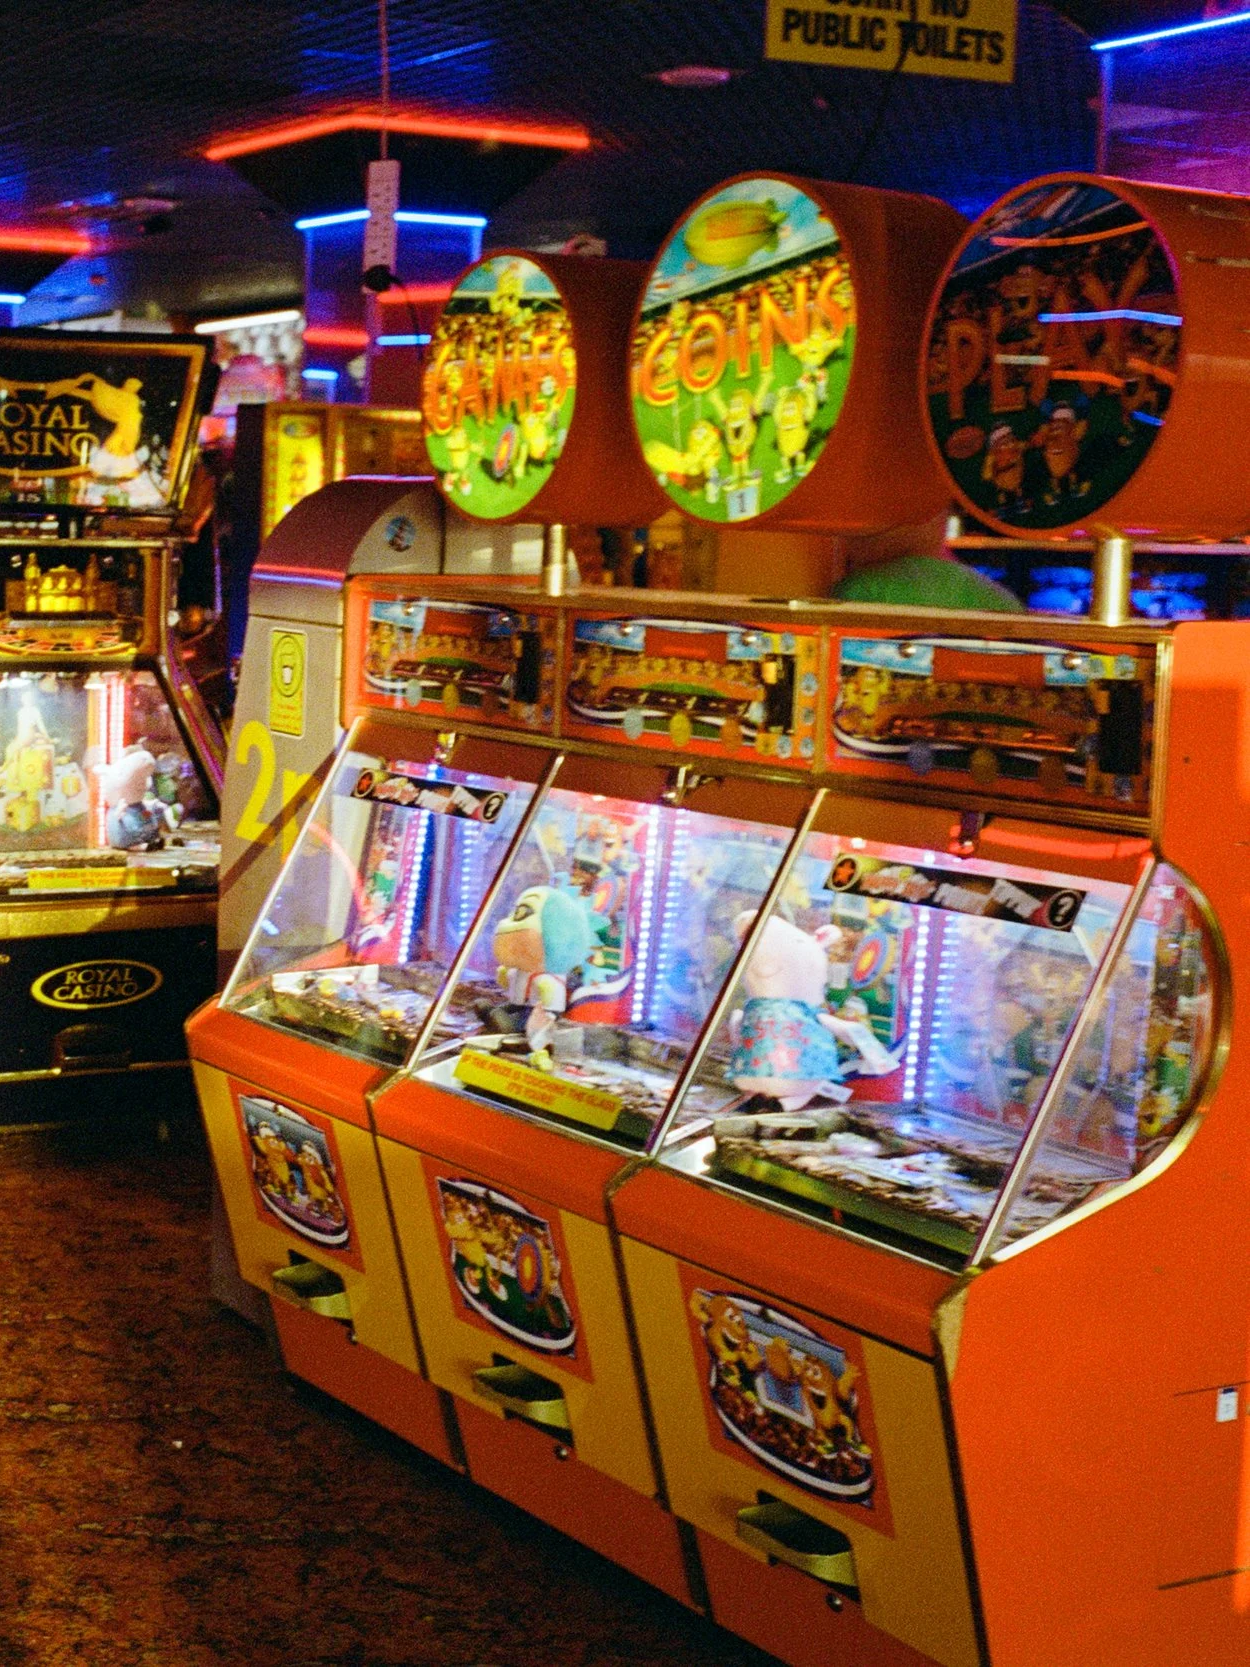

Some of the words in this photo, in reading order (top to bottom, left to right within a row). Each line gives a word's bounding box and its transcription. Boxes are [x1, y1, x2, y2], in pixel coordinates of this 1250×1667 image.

[782, 7, 888, 51] PUBLIC
[896, 19, 1005, 65] TOILETS
[638, 262, 847, 408] COINS
[946, 252, 1150, 421] PLAY
[424, 330, 573, 436] GAMES
[52, 981, 139, 1001] CASINO
[64, 968, 134, 985] ROYAL
